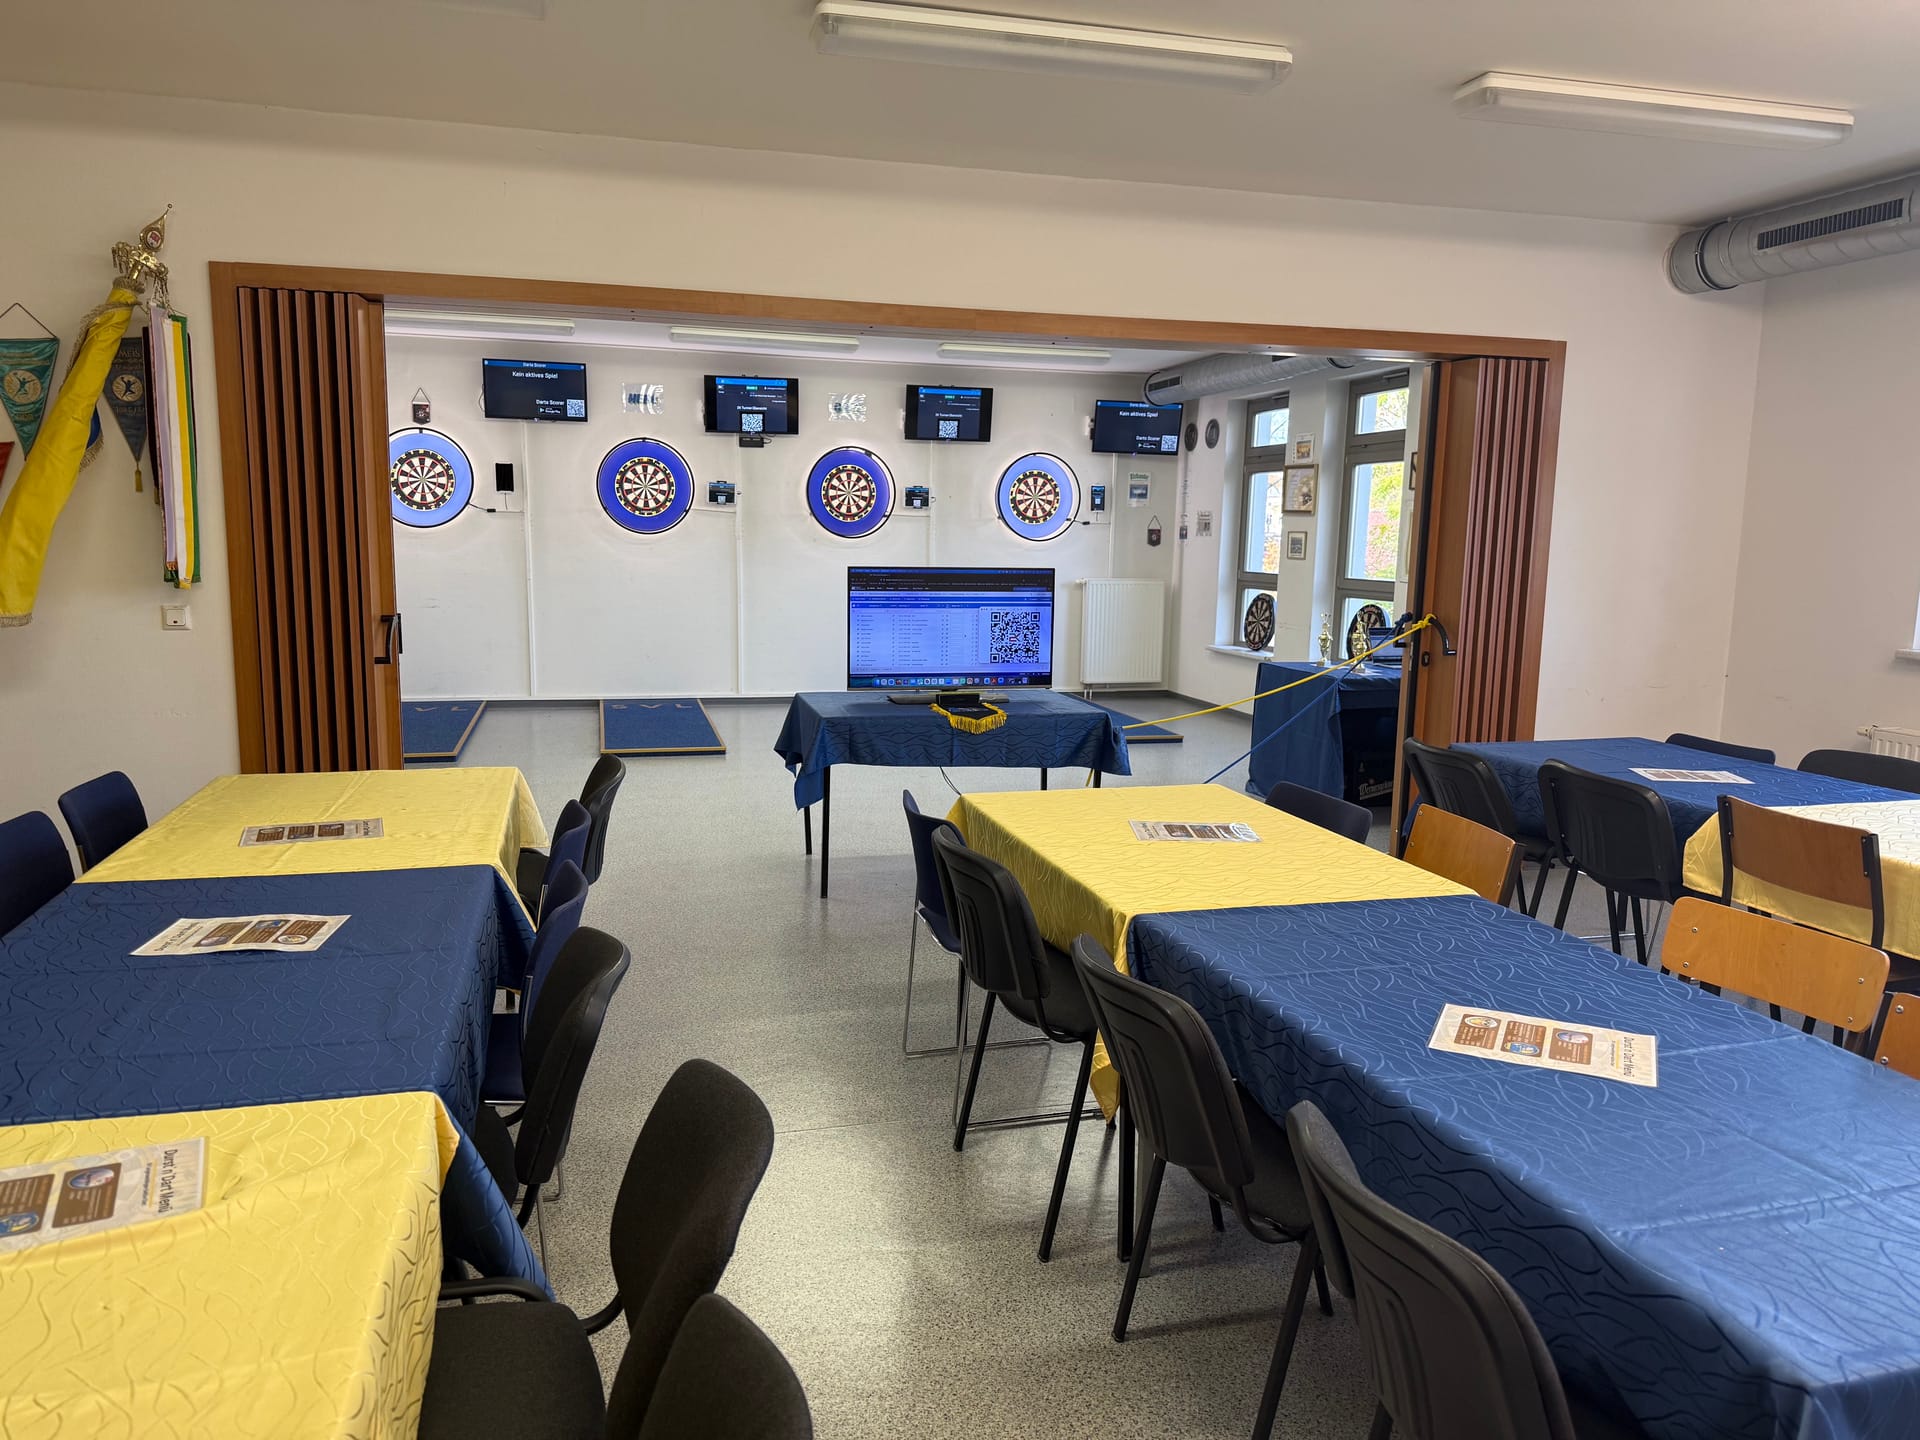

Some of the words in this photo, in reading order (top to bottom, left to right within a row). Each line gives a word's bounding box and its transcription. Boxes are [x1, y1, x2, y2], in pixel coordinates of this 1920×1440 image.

[545, 372, 559, 380] Spiel
[160, 1174, 176, 1192] Dart
[158, 1191, 174, 1213] Menü
